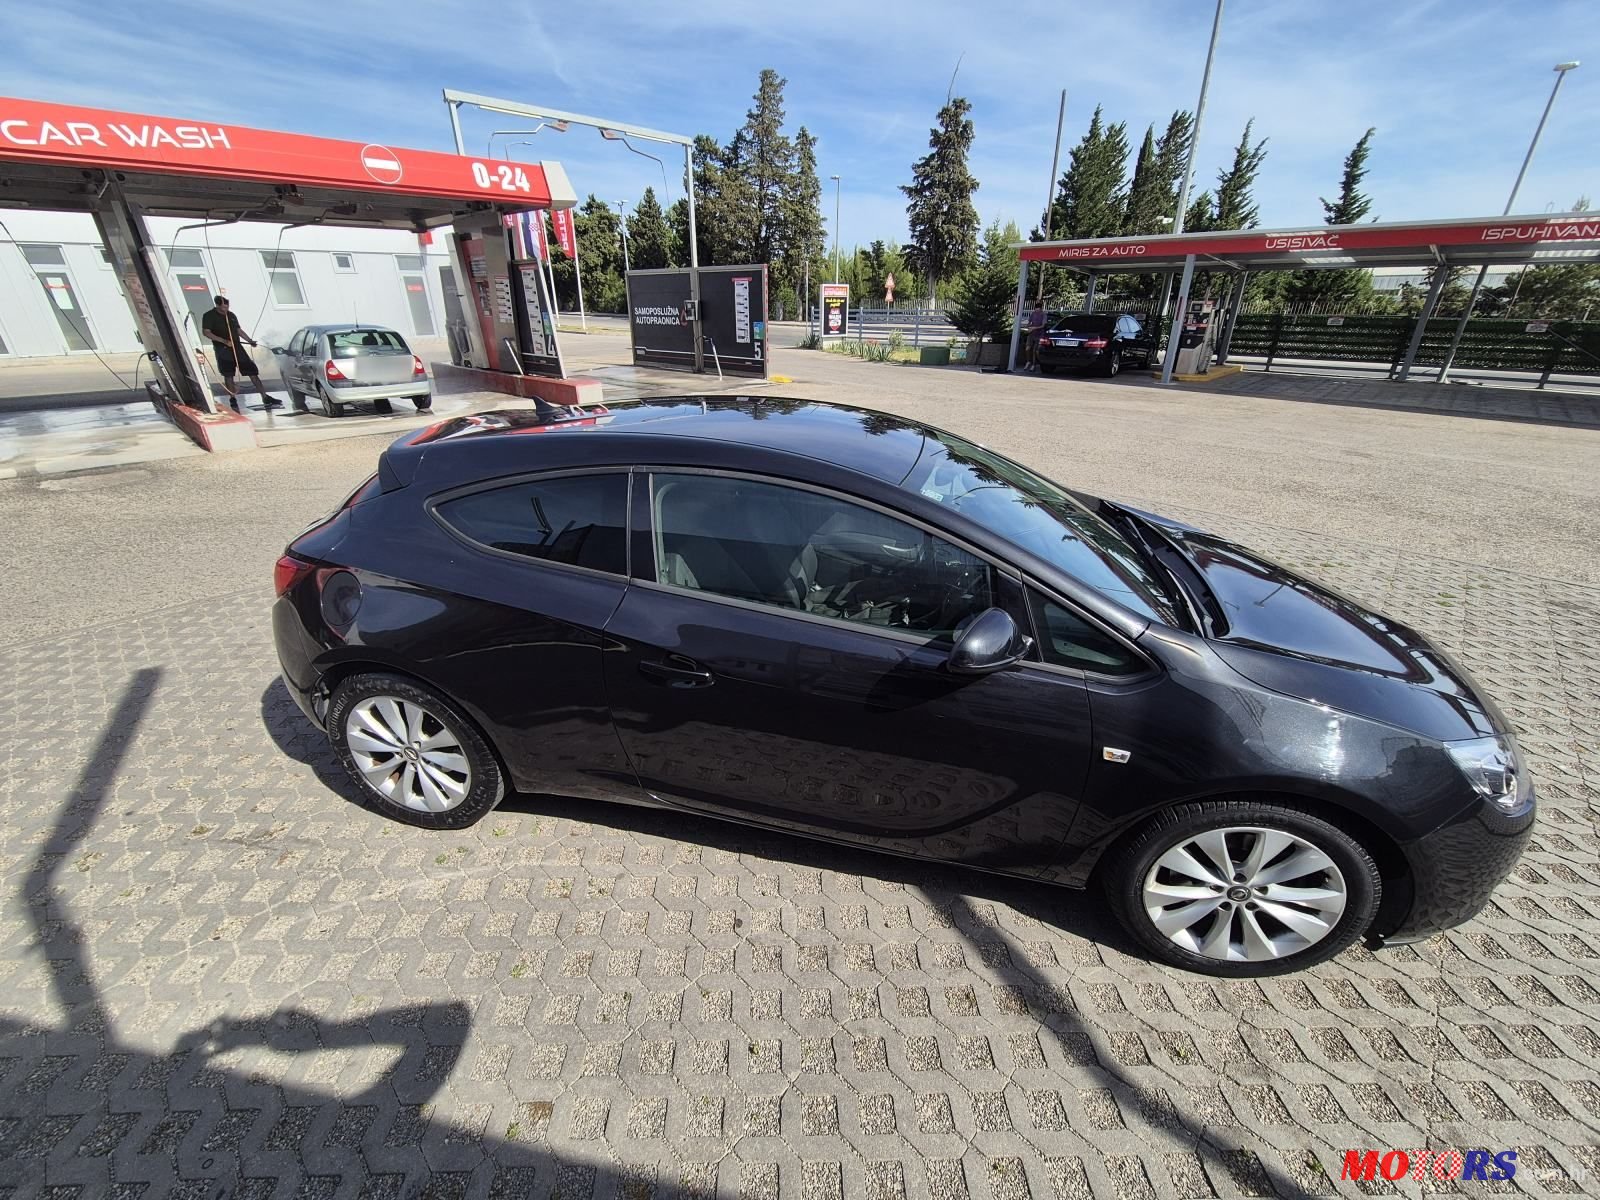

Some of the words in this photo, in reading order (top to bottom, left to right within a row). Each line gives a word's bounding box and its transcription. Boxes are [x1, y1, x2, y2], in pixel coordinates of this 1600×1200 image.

[0, 119, 108, 147] CAR
[107, 123, 231, 149] WASH
[471, 162, 531, 193] 0-24
[1480, 223, 1600, 240] ISPUHIVAN
[1265, 234, 1340, 249] USISIVAČ
[1058, 247, 1090, 258] MIRIS
[1091, 246, 1108, 256] ZA
[1110, 245, 1146, 256] AUTO
[634, 305, 680, 316] SAMOPOSLUŽNA
[635, 316, 681, 326] AUTOPRAONICA
[547, 335, 556, 357] 4
[754, 341, 762, 359] 5
